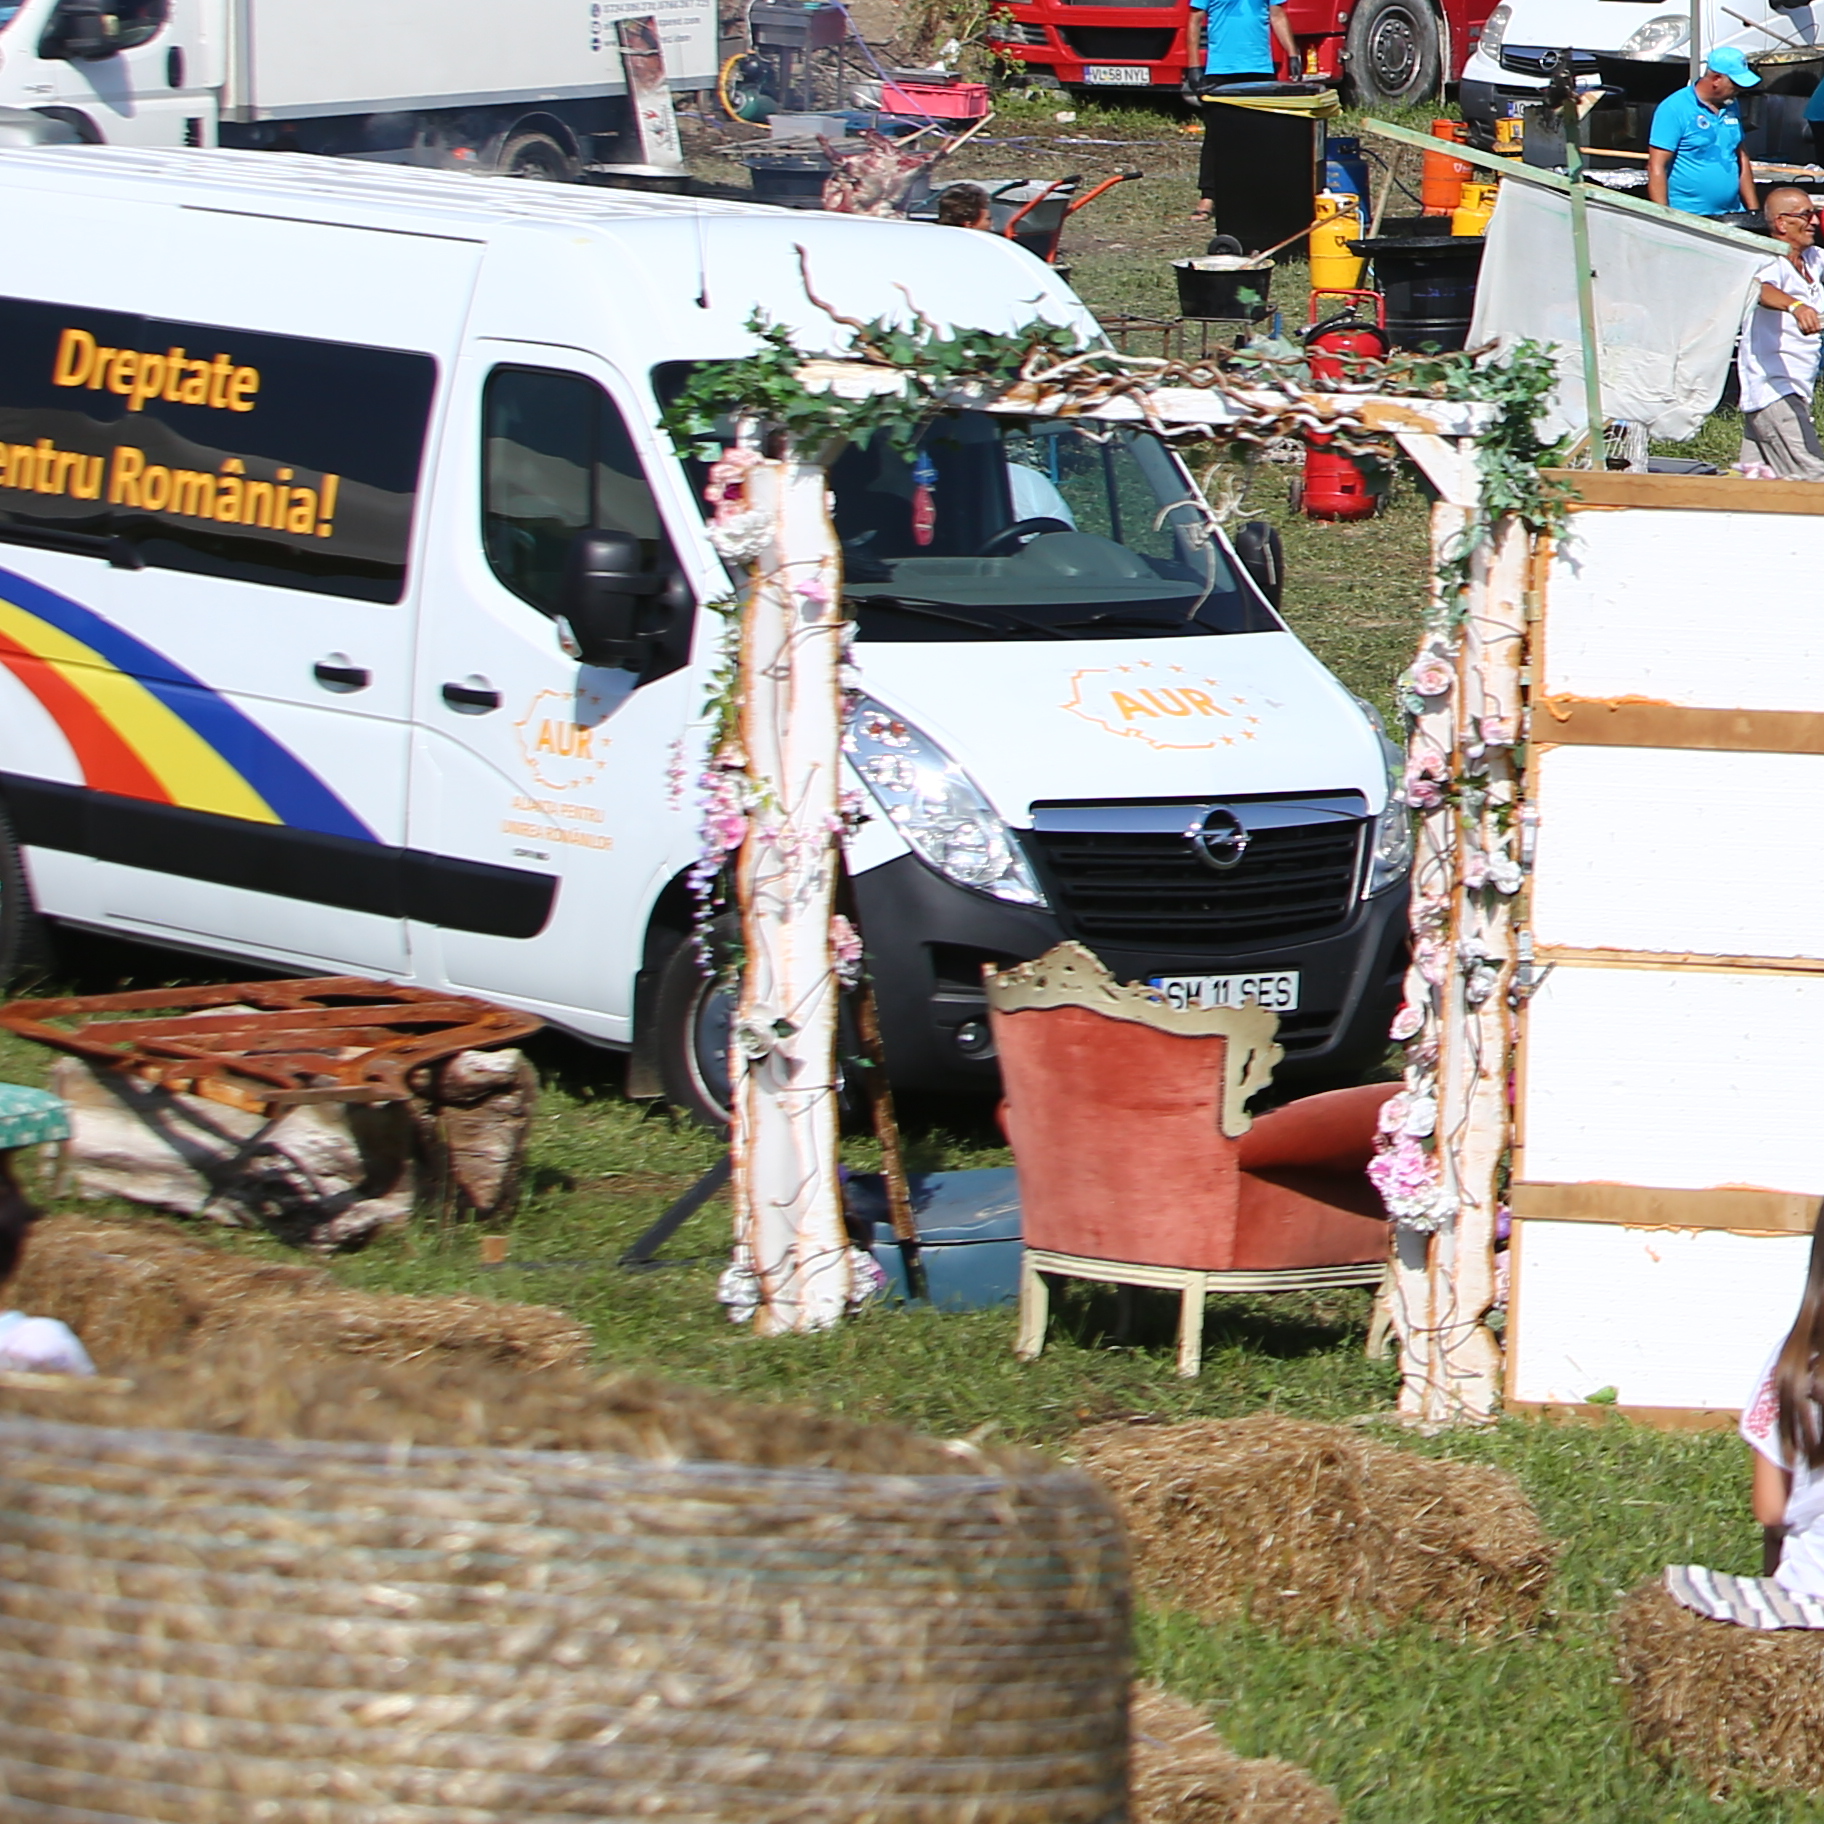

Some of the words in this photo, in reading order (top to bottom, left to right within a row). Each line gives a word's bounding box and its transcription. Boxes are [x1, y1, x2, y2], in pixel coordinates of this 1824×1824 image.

[52, 327, 260, 412] Dreptate
[0, 438, 105, 500] ntru
[108, 445, 341, 538] România!
[1109, 687, 1233, 720] AUR
[536, 718, 594, 760] AUR
[1213, 979, 1229, 1005] 11
[1242, 976, 1292, 1008] SES
